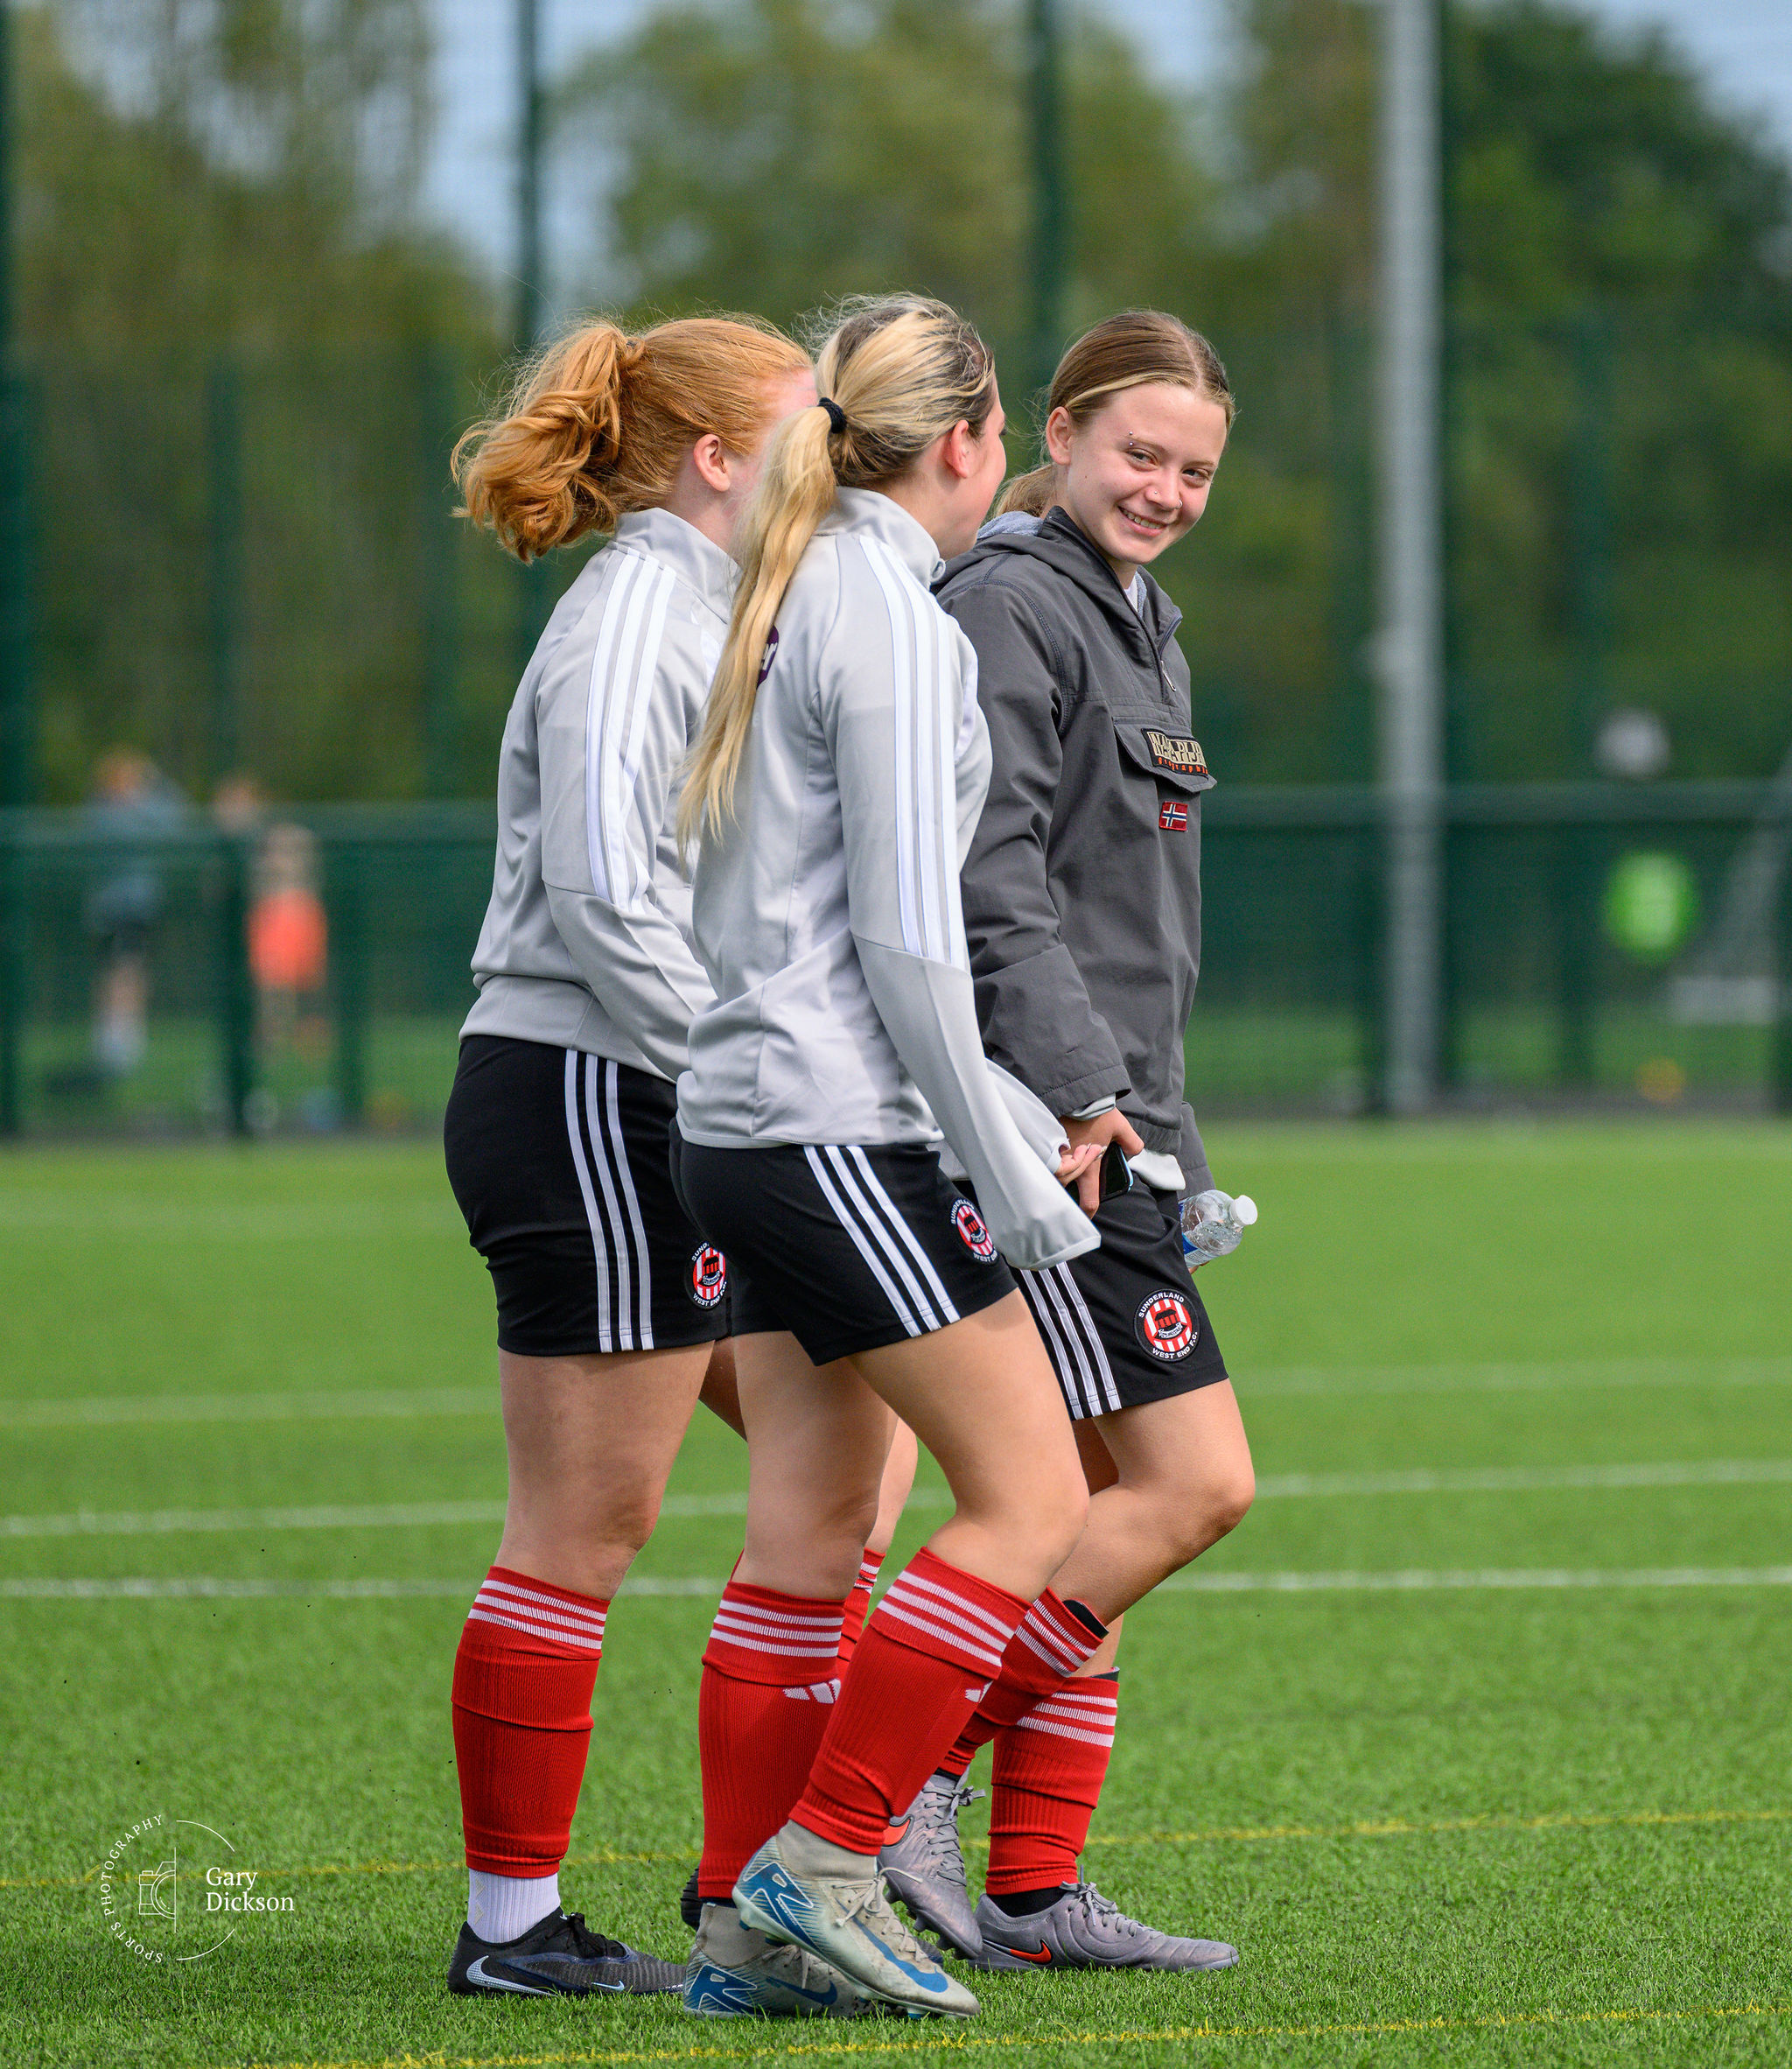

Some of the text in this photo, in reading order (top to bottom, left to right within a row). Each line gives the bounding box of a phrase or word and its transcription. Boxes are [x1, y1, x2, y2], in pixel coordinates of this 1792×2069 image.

[693, 1293, 710, 1307] WEST
[1138, 1292, 1185, 1318] SUNDERLAND
[1152, 1331, 1198, 1359] WEST END F.C.
